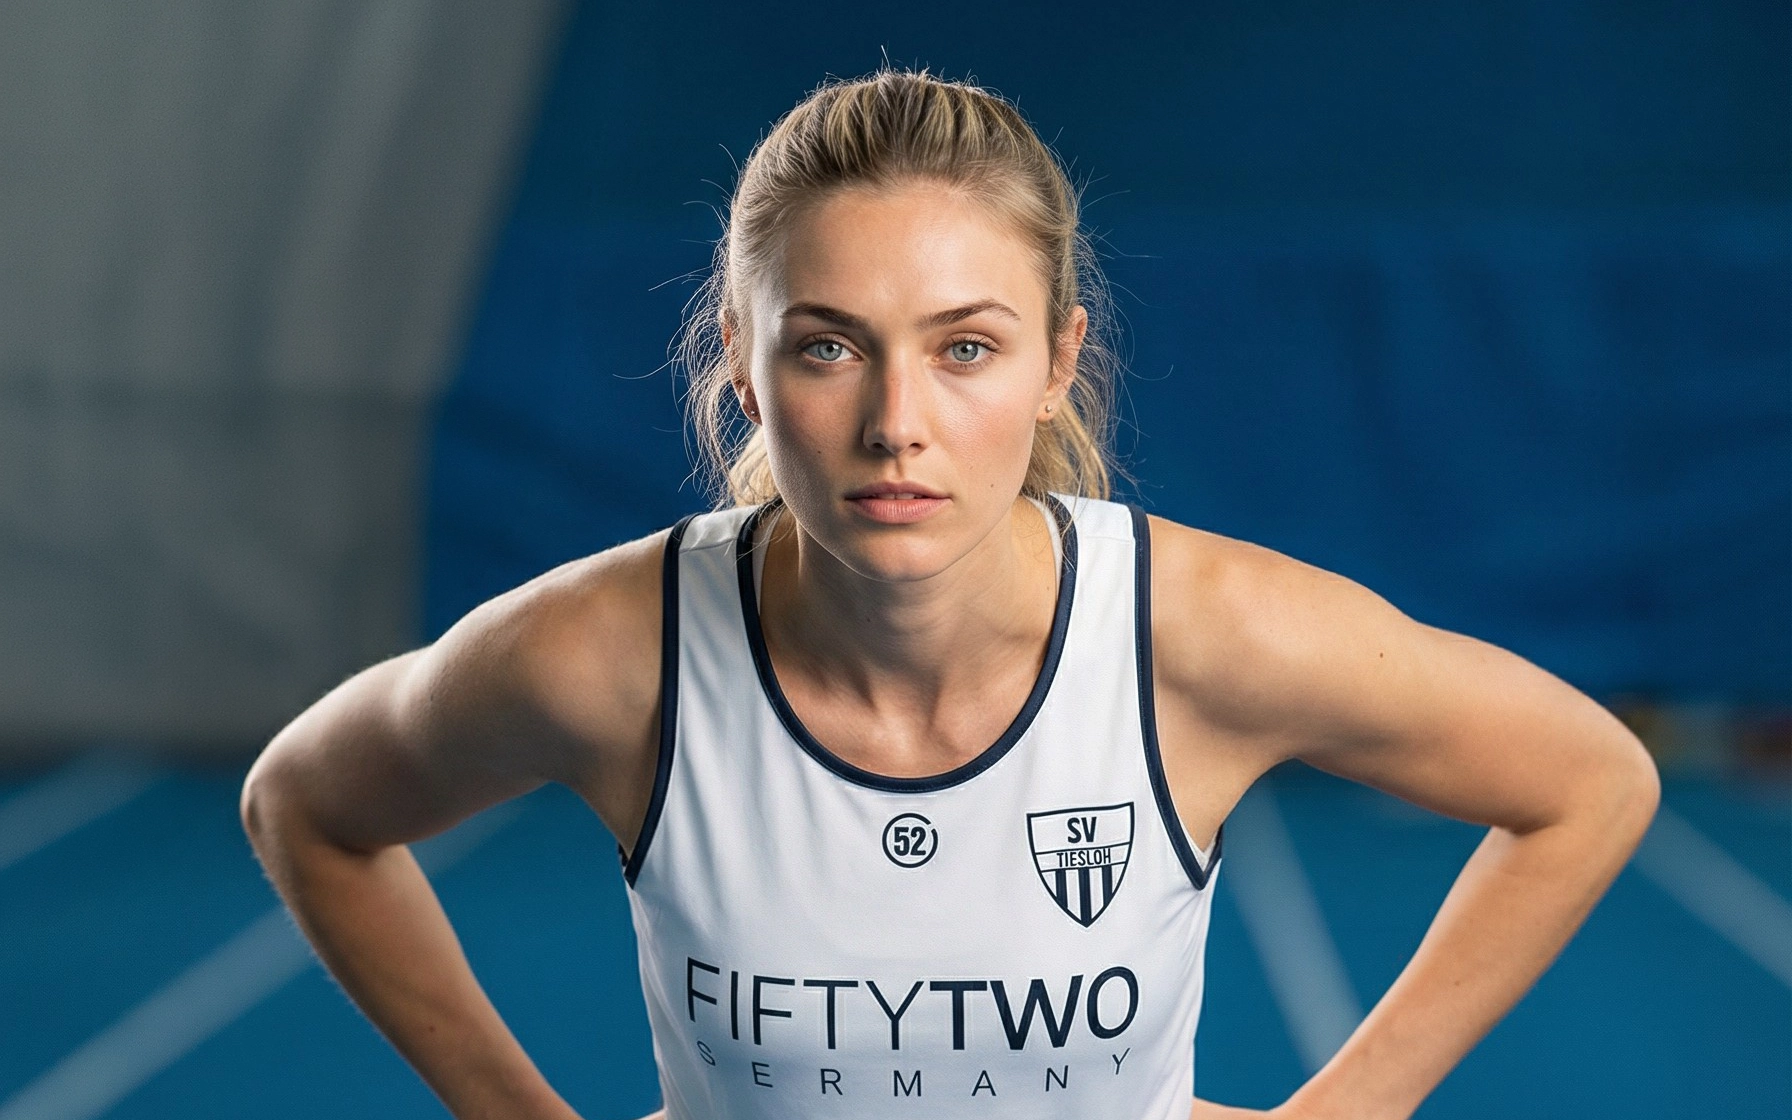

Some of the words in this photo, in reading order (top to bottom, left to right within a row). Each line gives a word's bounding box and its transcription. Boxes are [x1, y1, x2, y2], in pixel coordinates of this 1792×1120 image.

[894, 826, 926, 856] 52
[1067, 816, 1097, 844] SV
[1056, 848, 1111, 868] TIESLOH
[687, 956, 1139, 1051] FIFTYTWO
